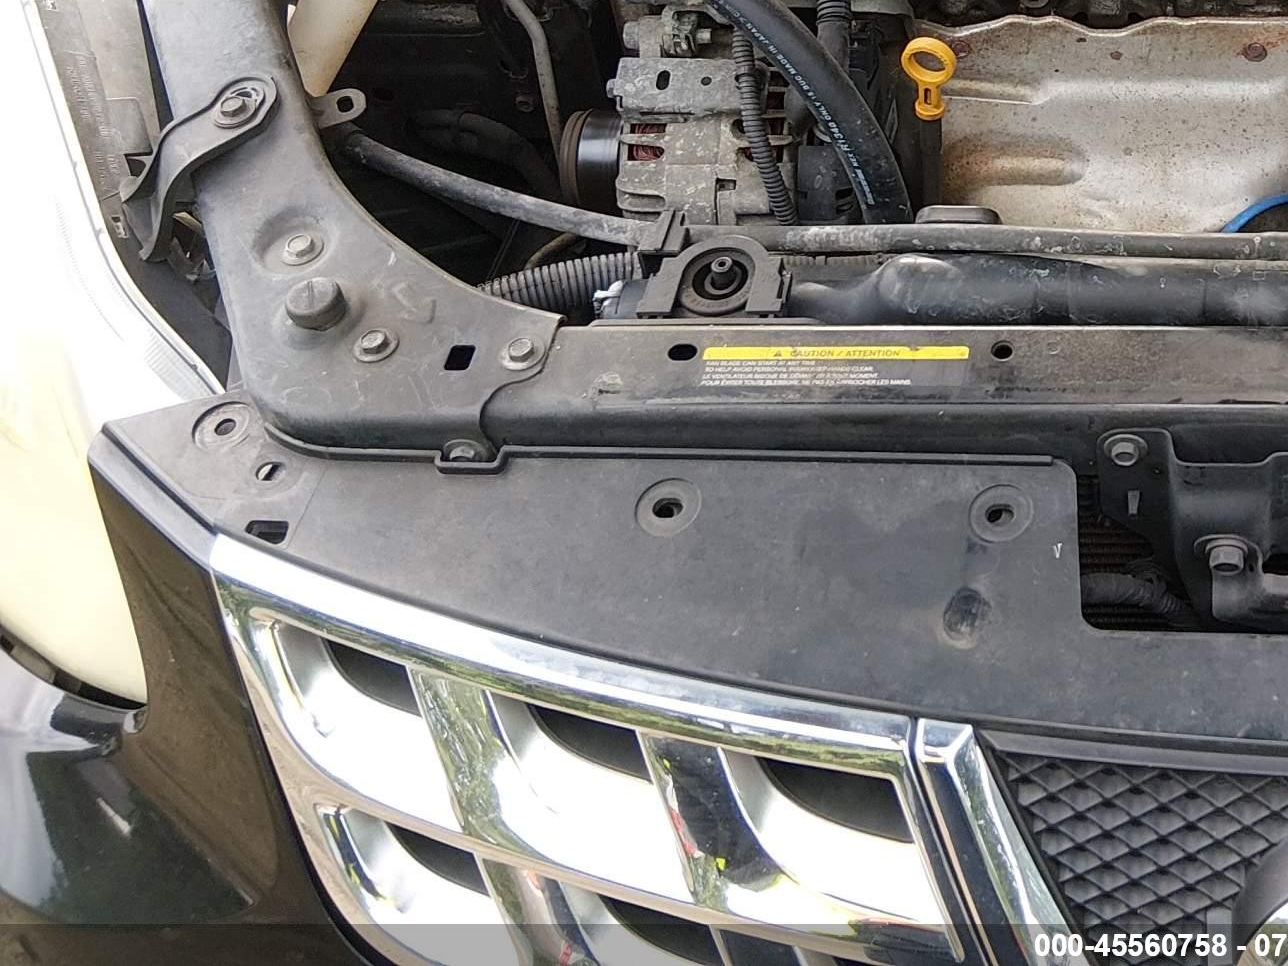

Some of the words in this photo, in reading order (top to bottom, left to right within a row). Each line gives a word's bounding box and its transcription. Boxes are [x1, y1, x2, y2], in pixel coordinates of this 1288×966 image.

[745, 21, 771, 45] JAPAN
[777, 53, 798, 76] MADE
[790, 349, 836, 357] CAUTION
[845, 349, 900, 357] ATTENTION
